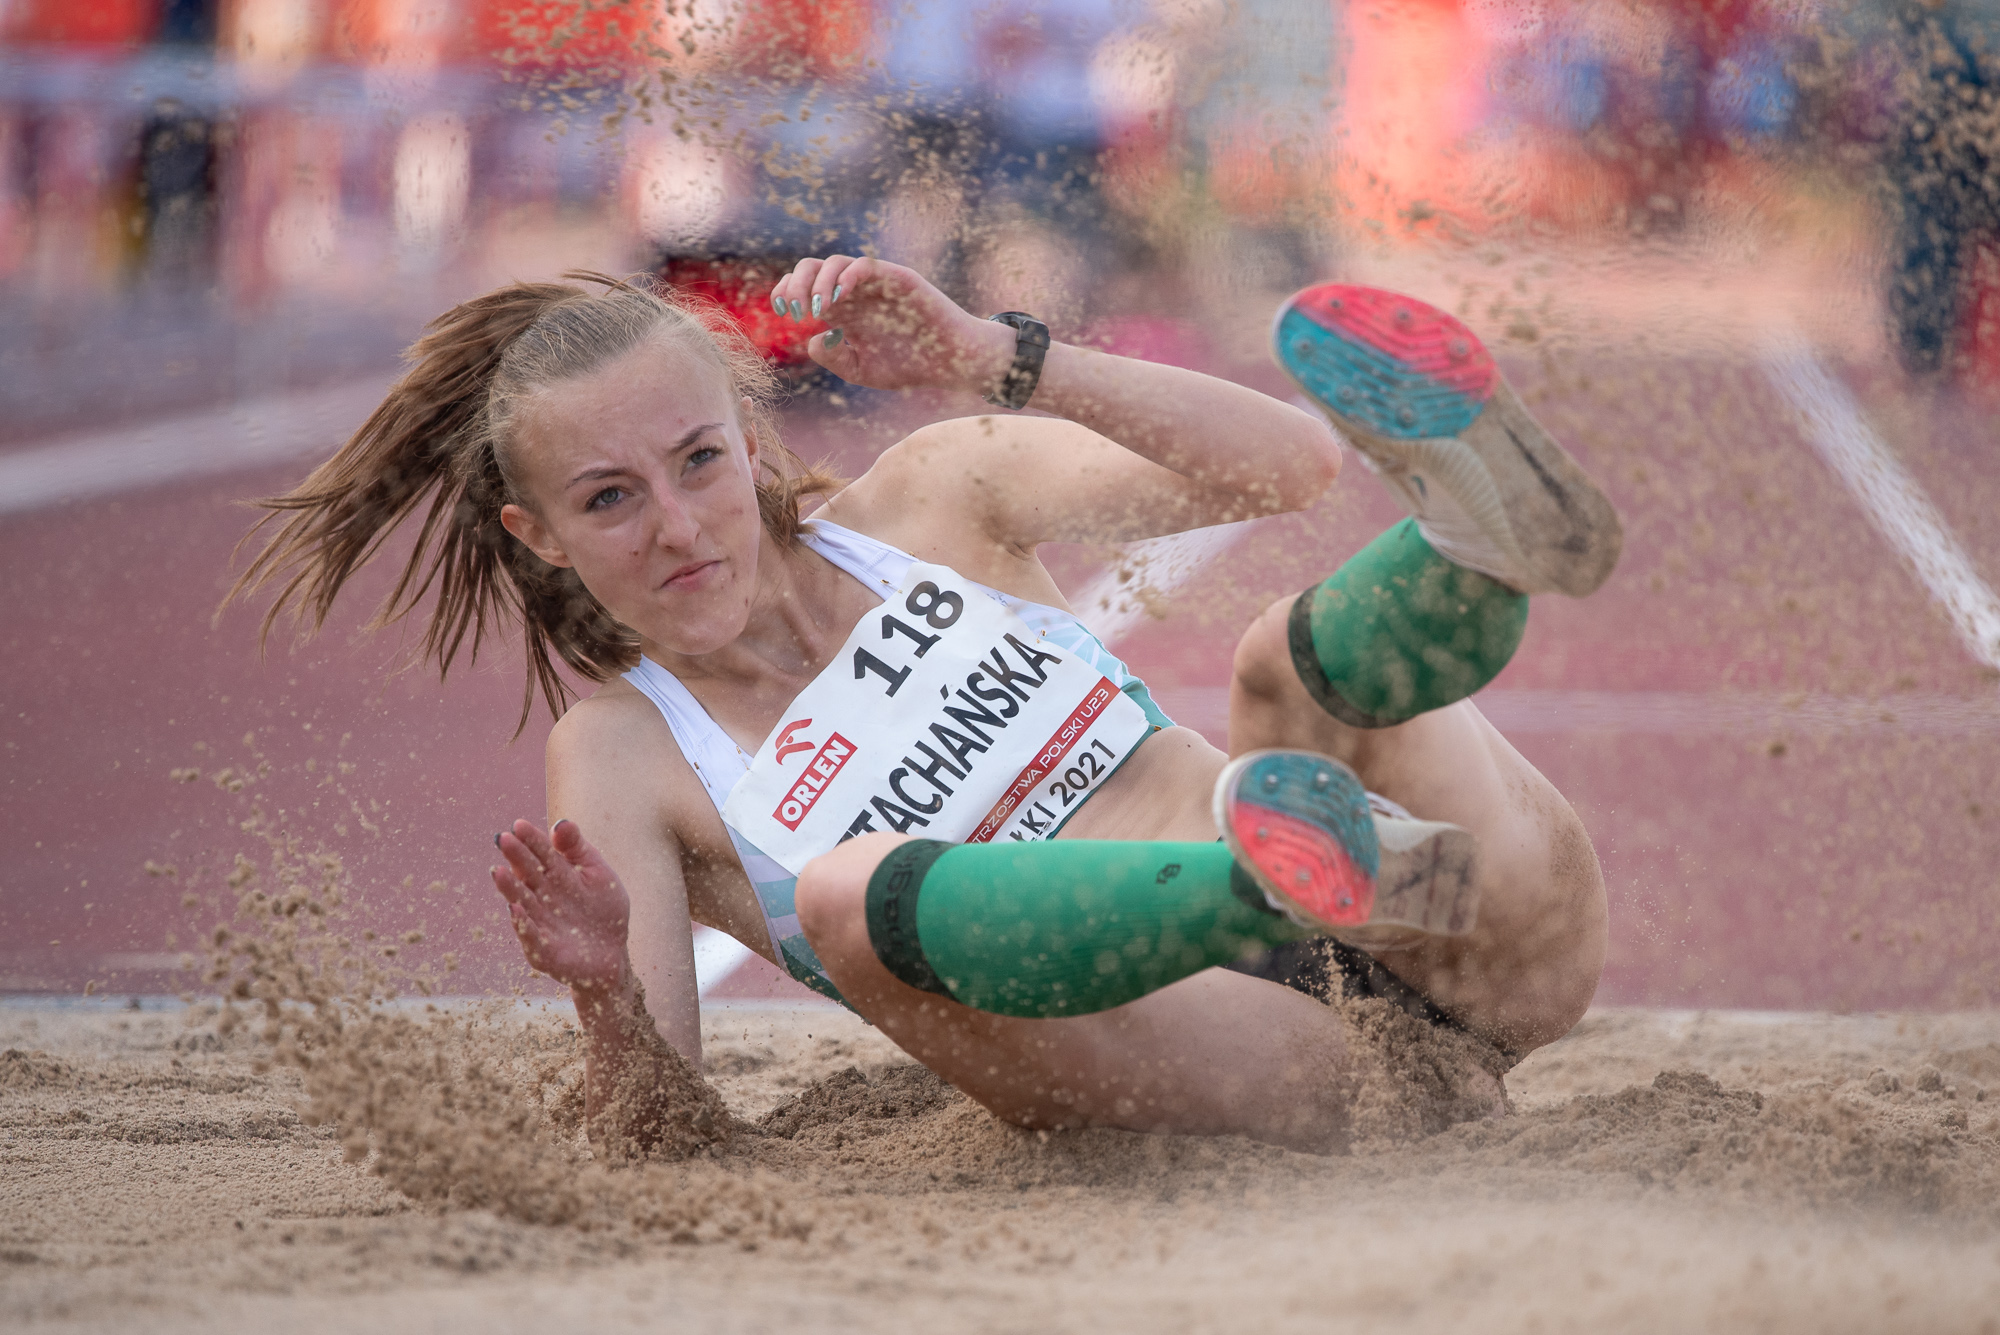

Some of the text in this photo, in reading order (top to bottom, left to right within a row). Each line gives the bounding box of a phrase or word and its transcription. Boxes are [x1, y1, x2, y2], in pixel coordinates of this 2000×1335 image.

[853, 580, 964, 697] 118
[781, 738, 851, 822] ORLEN
[834, 632, 1062, 848] TACHAŃSKA
[970, 688, 1109, 844] TRZOSTWA POLSKI U23
[1049, 738, 1116, 807] 2021
